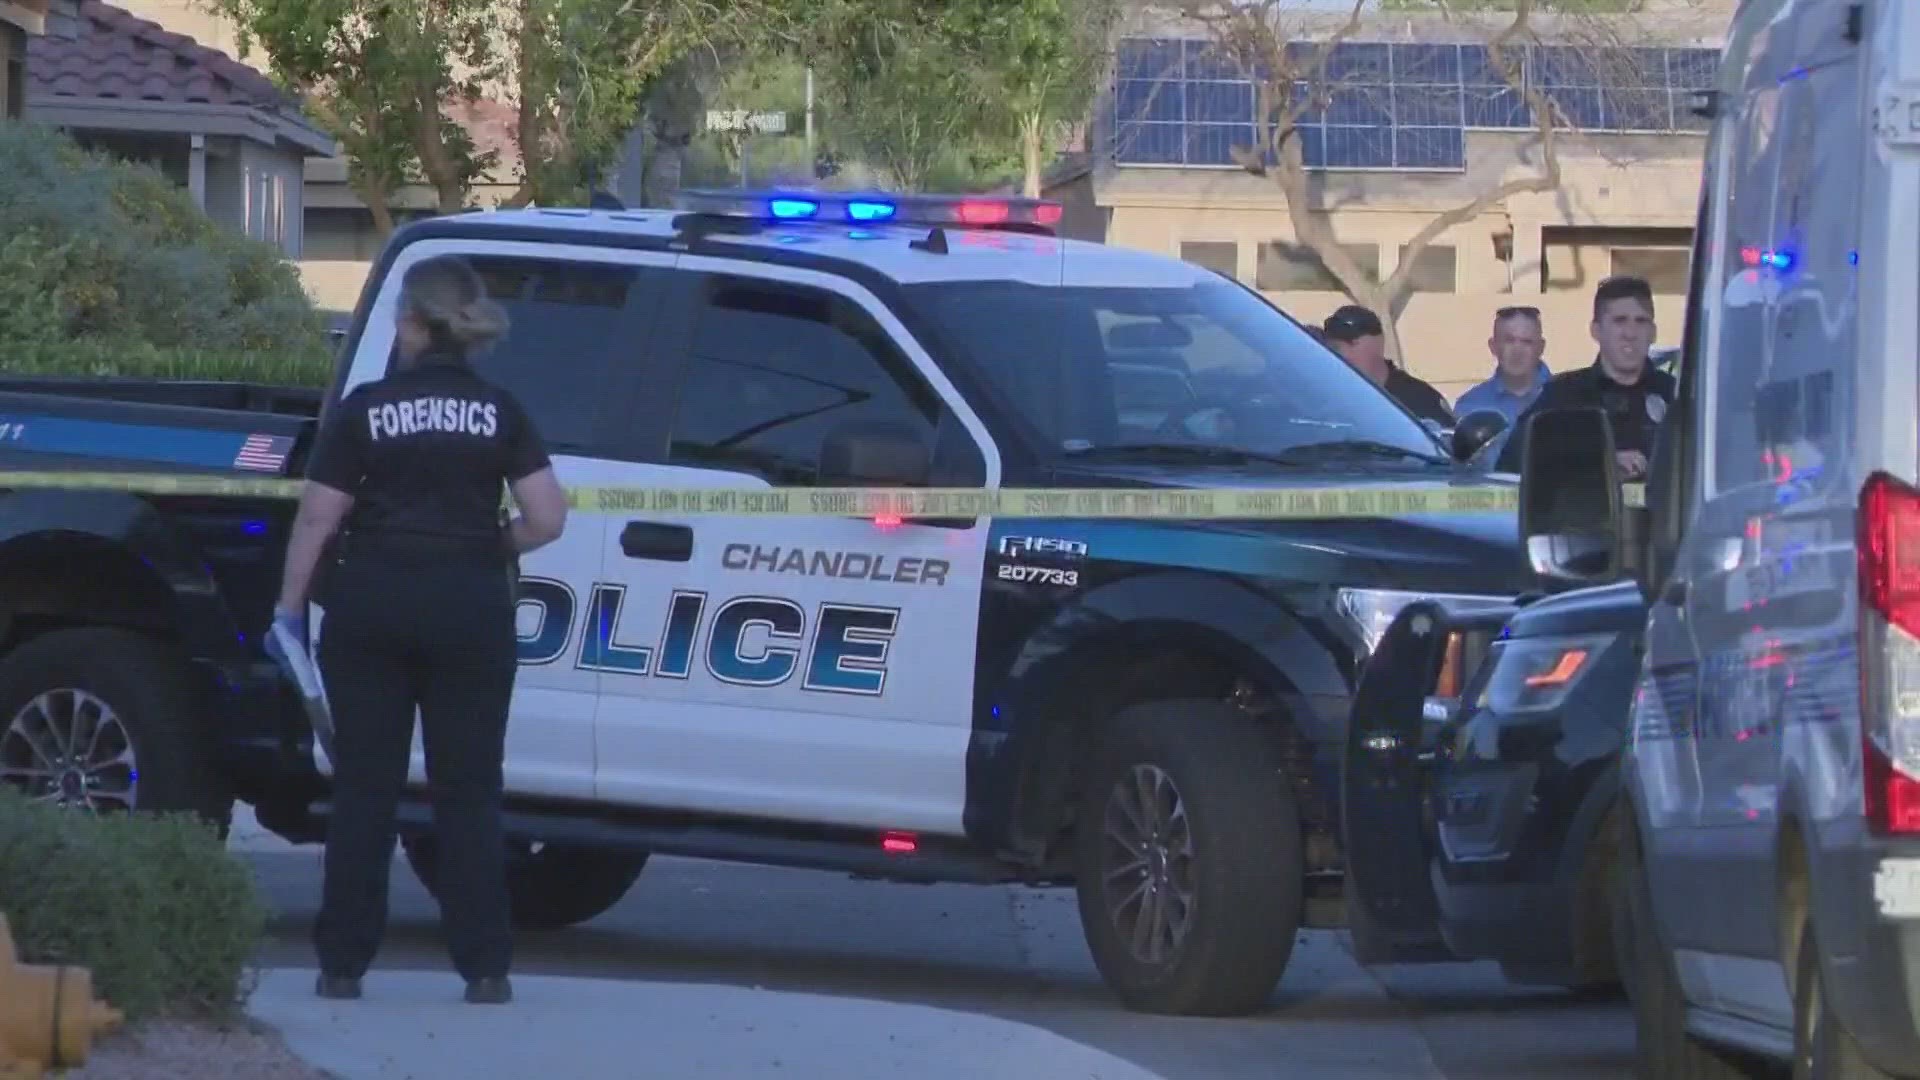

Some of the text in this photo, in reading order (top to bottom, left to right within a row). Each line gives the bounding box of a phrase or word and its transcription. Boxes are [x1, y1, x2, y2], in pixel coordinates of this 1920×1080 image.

[367, 397, 497, 441] FORENSICS
[721, 542, 950, 586] CHANDLER
[998, 564, 1079, 587] 207733
[514, 574, 902, 696] OLICE
